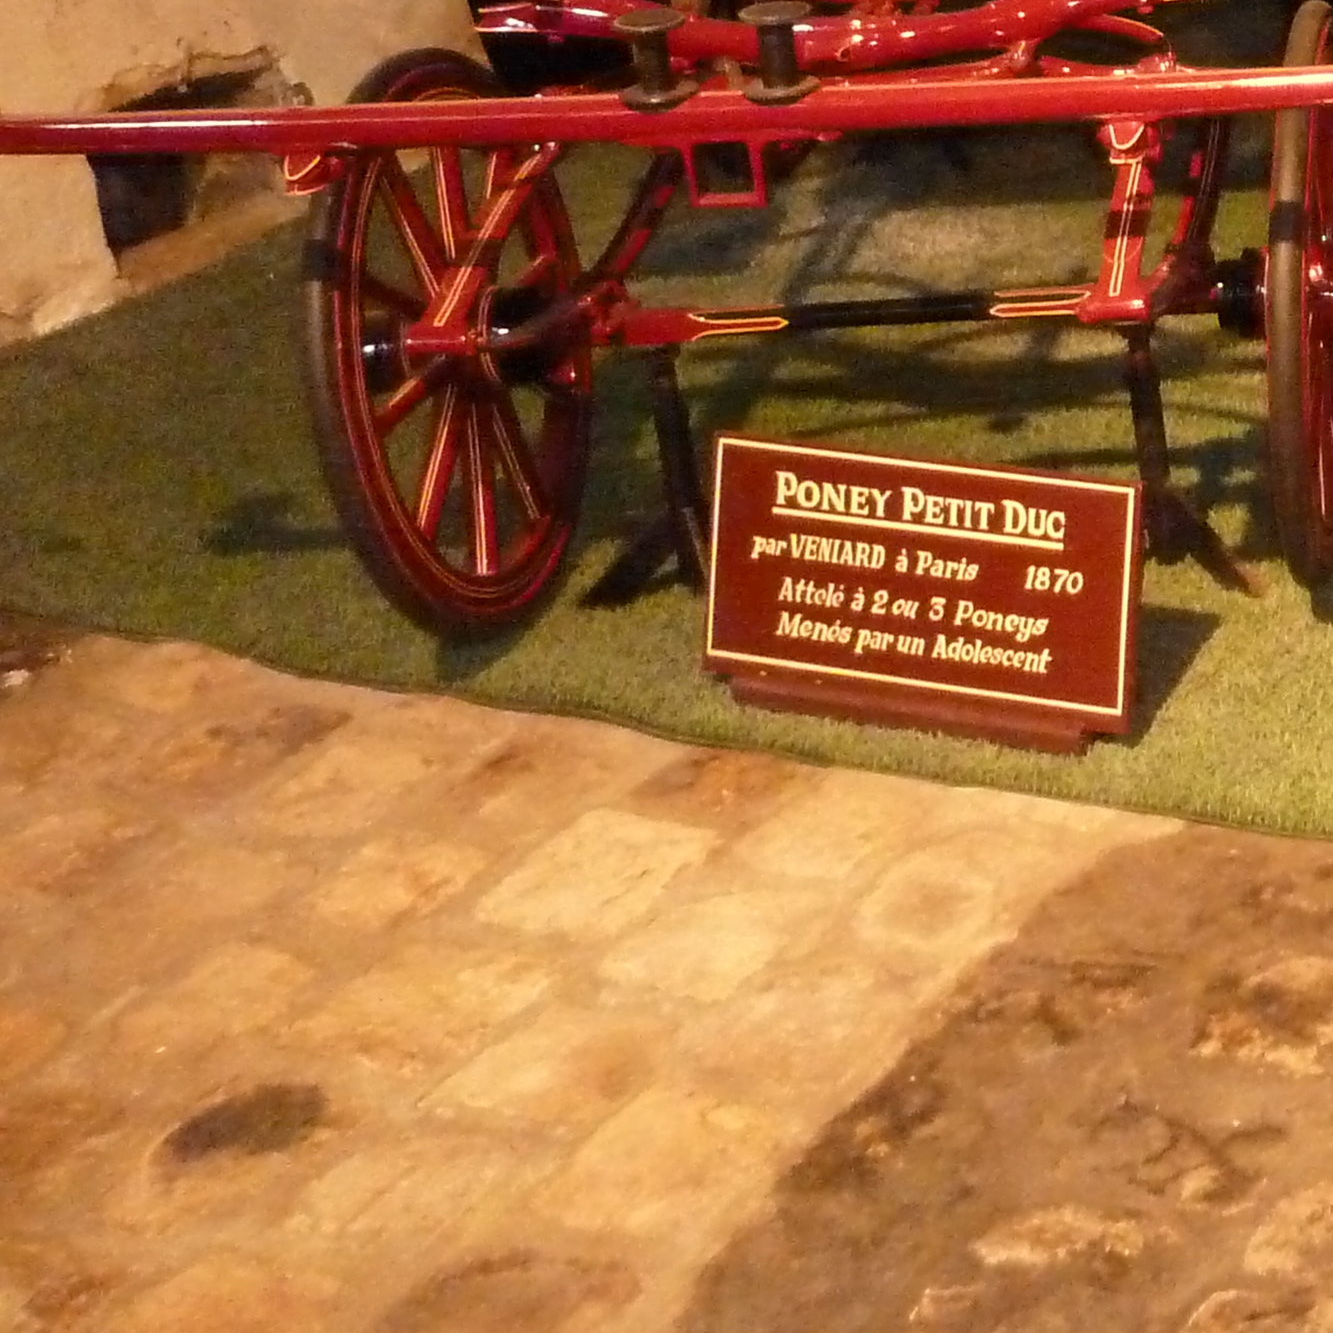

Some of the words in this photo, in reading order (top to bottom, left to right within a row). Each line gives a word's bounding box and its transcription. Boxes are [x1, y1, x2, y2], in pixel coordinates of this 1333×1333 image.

[775, 471, 892, 517] PONEY
[901, 486, 994, 531] PETIT
[1002, 500, 1065, 539] DUC
[751, 535, 787, 559] par
[789, 534, 885, 569] VENIARD
[895, 548, 908, 573] à
[916, 551, 979, 581] Paris
[1024, 566, 1083, 594] 1870
[778, 577, 844, 608] Attelé
[850, 586, 864, 612] à
[871, 590, 888, 614] 2
[892, 599, 918, 618] ou
[928, 597, 945, 622] 3
[954, 600, 1049, 642] Poneys
[775, 611, 850, 643] Menés
[856, 628, 894, 654] par
[898, 635, 925, 656] un
[931, 634, 1052, 674] Adolescent
